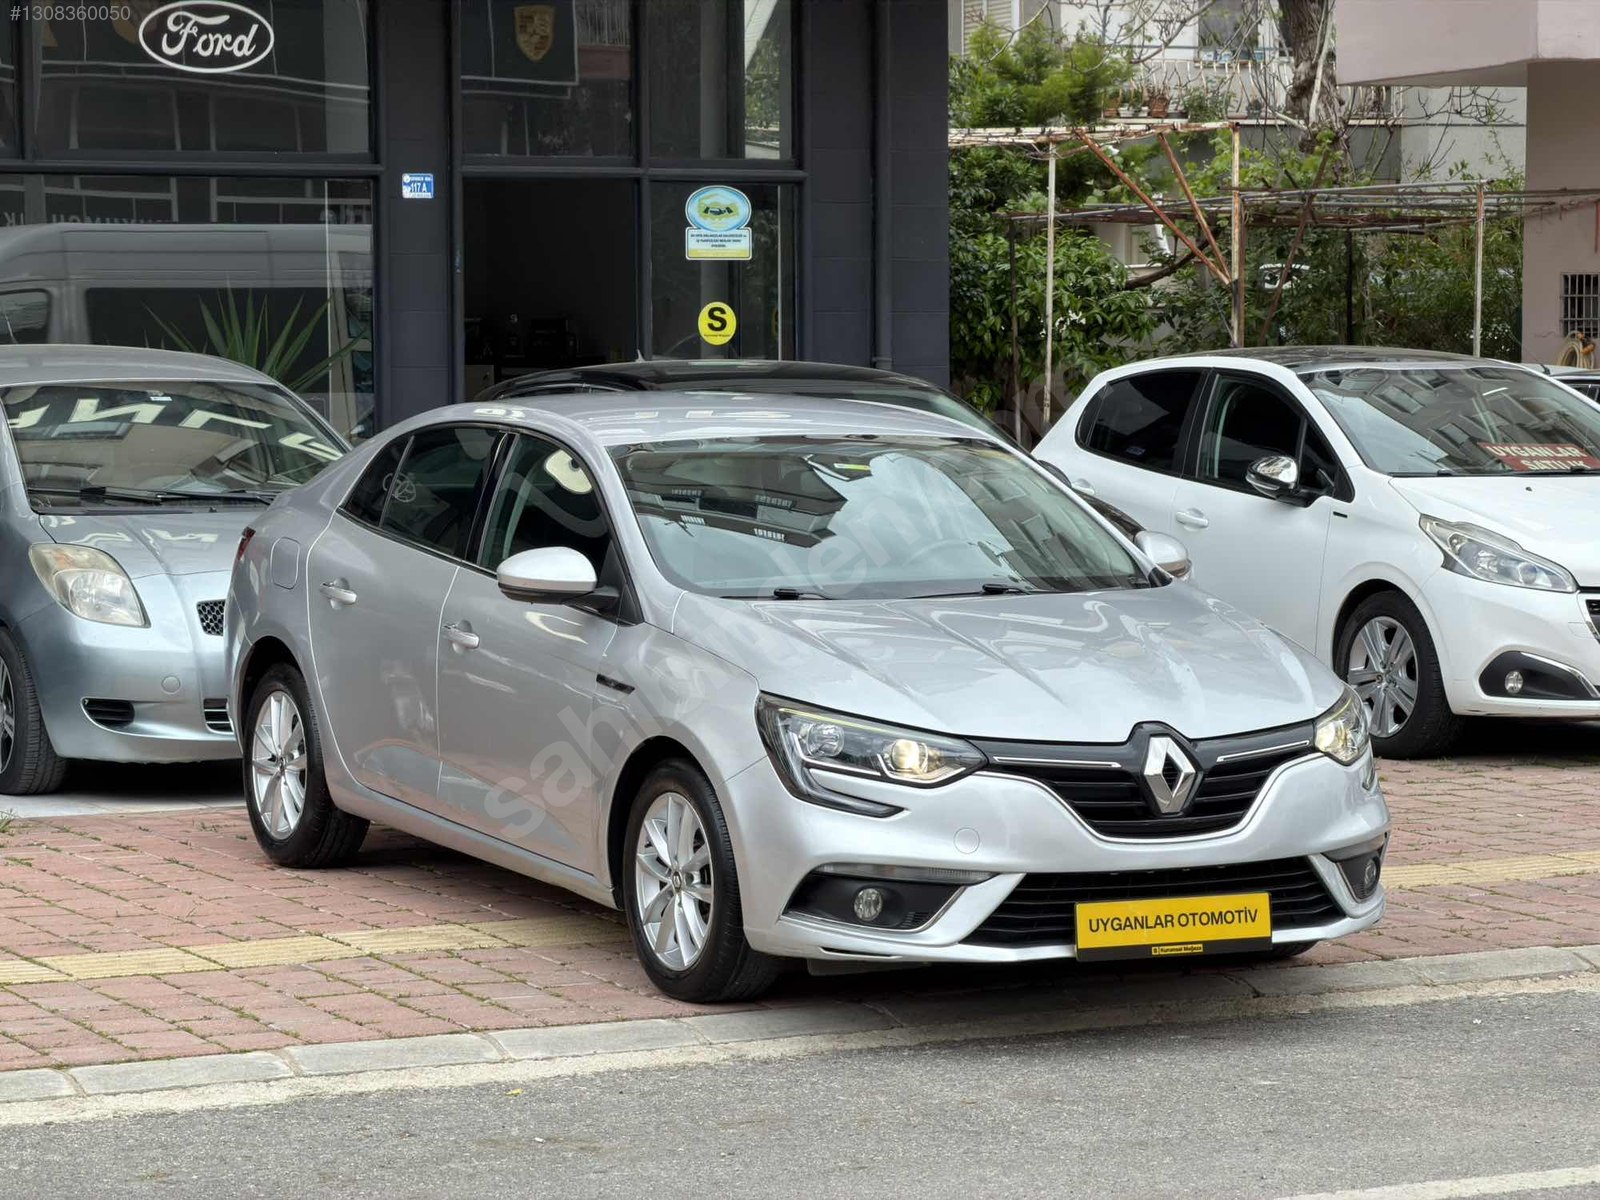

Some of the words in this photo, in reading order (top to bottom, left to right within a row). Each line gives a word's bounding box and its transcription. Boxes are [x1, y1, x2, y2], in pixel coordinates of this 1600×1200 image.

[161, 11, 259, 57] Ford
[708, 307, 727, 331] S
[1486, 446, 1588, 457] UYGANLAR
[1089, 914, 1175, 932] UYGANLAR
[1178, 906, 1258, 926] OTOMOTİV
